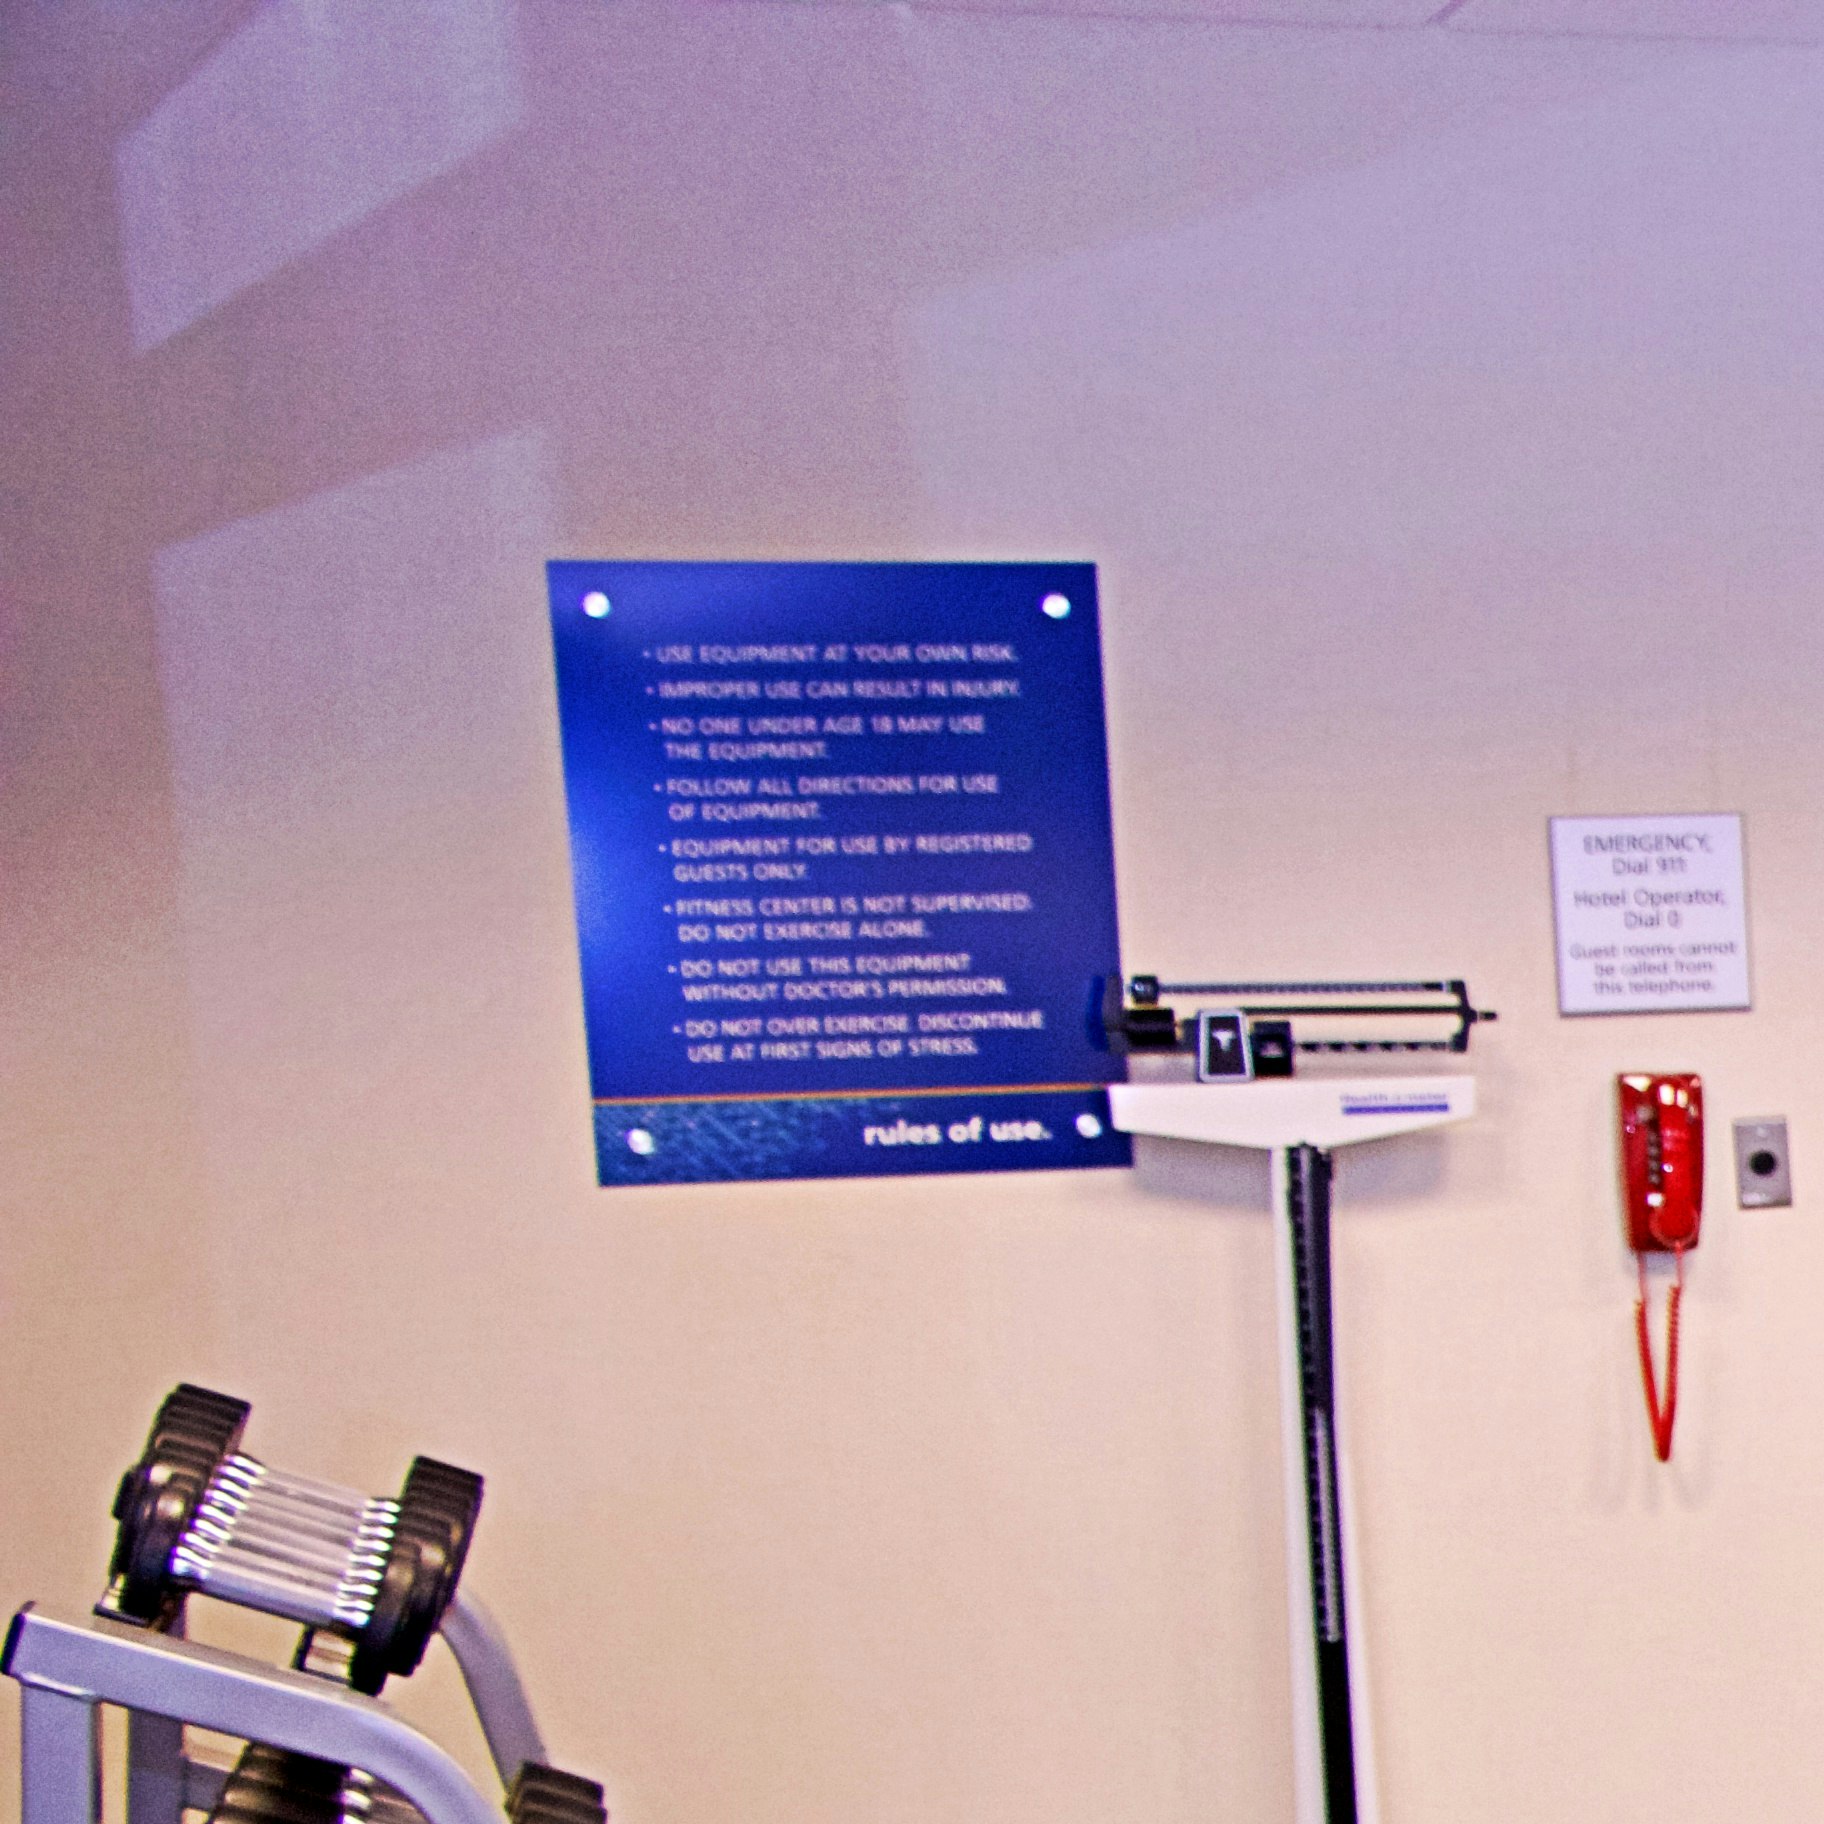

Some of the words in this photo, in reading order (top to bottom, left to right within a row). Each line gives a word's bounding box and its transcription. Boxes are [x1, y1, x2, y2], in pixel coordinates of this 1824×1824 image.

[656, 645, 693, 664] USE
[699, 645, 816, 664] EQUIPMENT
[823, 645, 847, 662] AT
[854, 645, 911, 663] YOUR
[914, 645, 969, 662] OWN
[658, 681, 760, 699] IMPROPER
[765, 681, 800, 699] USE
[805, 681, 849, 699] CAN
[852, 680, 921, 698] RESULT
[926, 681, 948, 698] IN
[661, 717, 695, 735] NO
[699, 717, 742, 735] ONE
[749, 716, 818, 734] UNDER
[822, 716, 863, 734] AGE
[871, 716, 894, 733] 18
[896, 715, 944, 733] MAY
[948, 715, 985, 733] USE
[665, 742, 702, 760] THE
[666, 778, 751, 796] FOLLOW
[757, 778, 793, 796] ALL
[797, 776, 914, 795] DIRECTIONS
[918, 775, 958, 793] FOR
[961, 774, 999, 793] USE
[668, 803, 696, 821] OF
[671, 836, 790, 857] EQUIPMENT
[795, 836, 836, 855] FOR
[840, 836, 878, 855] USE
[882, 835, 912, 854] BY
[915, 832, 1033, 853] REGISTERED
[673, 863, 749, 882] GUESTS
[1612, 856, 1649, 875] Dial
[675, 898, 753, 918] FITNESS
[758, 896, 836, 916] CENTER
[840, 896, 859, 915] IS
[862, 895, 906, 914] NOT
[1573, 889, 1627, 907] Hotel
[1624, 910, 1661, 929] Dial
[1667, 909, 1680, 929] 0
[677, 923, 711, 942] DO
[714, 922, 757, 941] NOT
[762, 921, 852, 941] EXERCISE
[1569, 942, 1618, 960] Guest
[1623, 943, 1675, 957] rooms
[1678, 940, 1736, 956] cannot
[680, 959, 713, 978] DO
[716, 958, 760, 977] NOT
[764, 957, 803, 976] USE
[806, 956, 850, 975] THIS
[854, 952, 971, 976] EQUIPMENT
[1594, 961, 1615, 977] be
[1620, 960, 1669, 976] called
[1674, 959, 1714, 974] from
[682, 981, 778, 1001] WITHOUT
[1593, 979, 1623, 994] this
[685, 1019, 717, 1038] DO
[720, 1018, 762, 1037] NOT
[766, 1016, 820, 1036] OVER
[917, 1010, 1044, 1032] DISCONTINUE
[687, 1043, 724, 1063] USE
[730, 1043, 755, 1061] AT
[759, 1041, 814, 1060] FIRST
[816, 1040, 873, 1059] SIGNS
[877, 1039, 902, 1058] OF
[863, 1117, 942, 1147] rules
[949, 1115, 984, 1143] of
[989, 1119, 1053, 1143] use.
